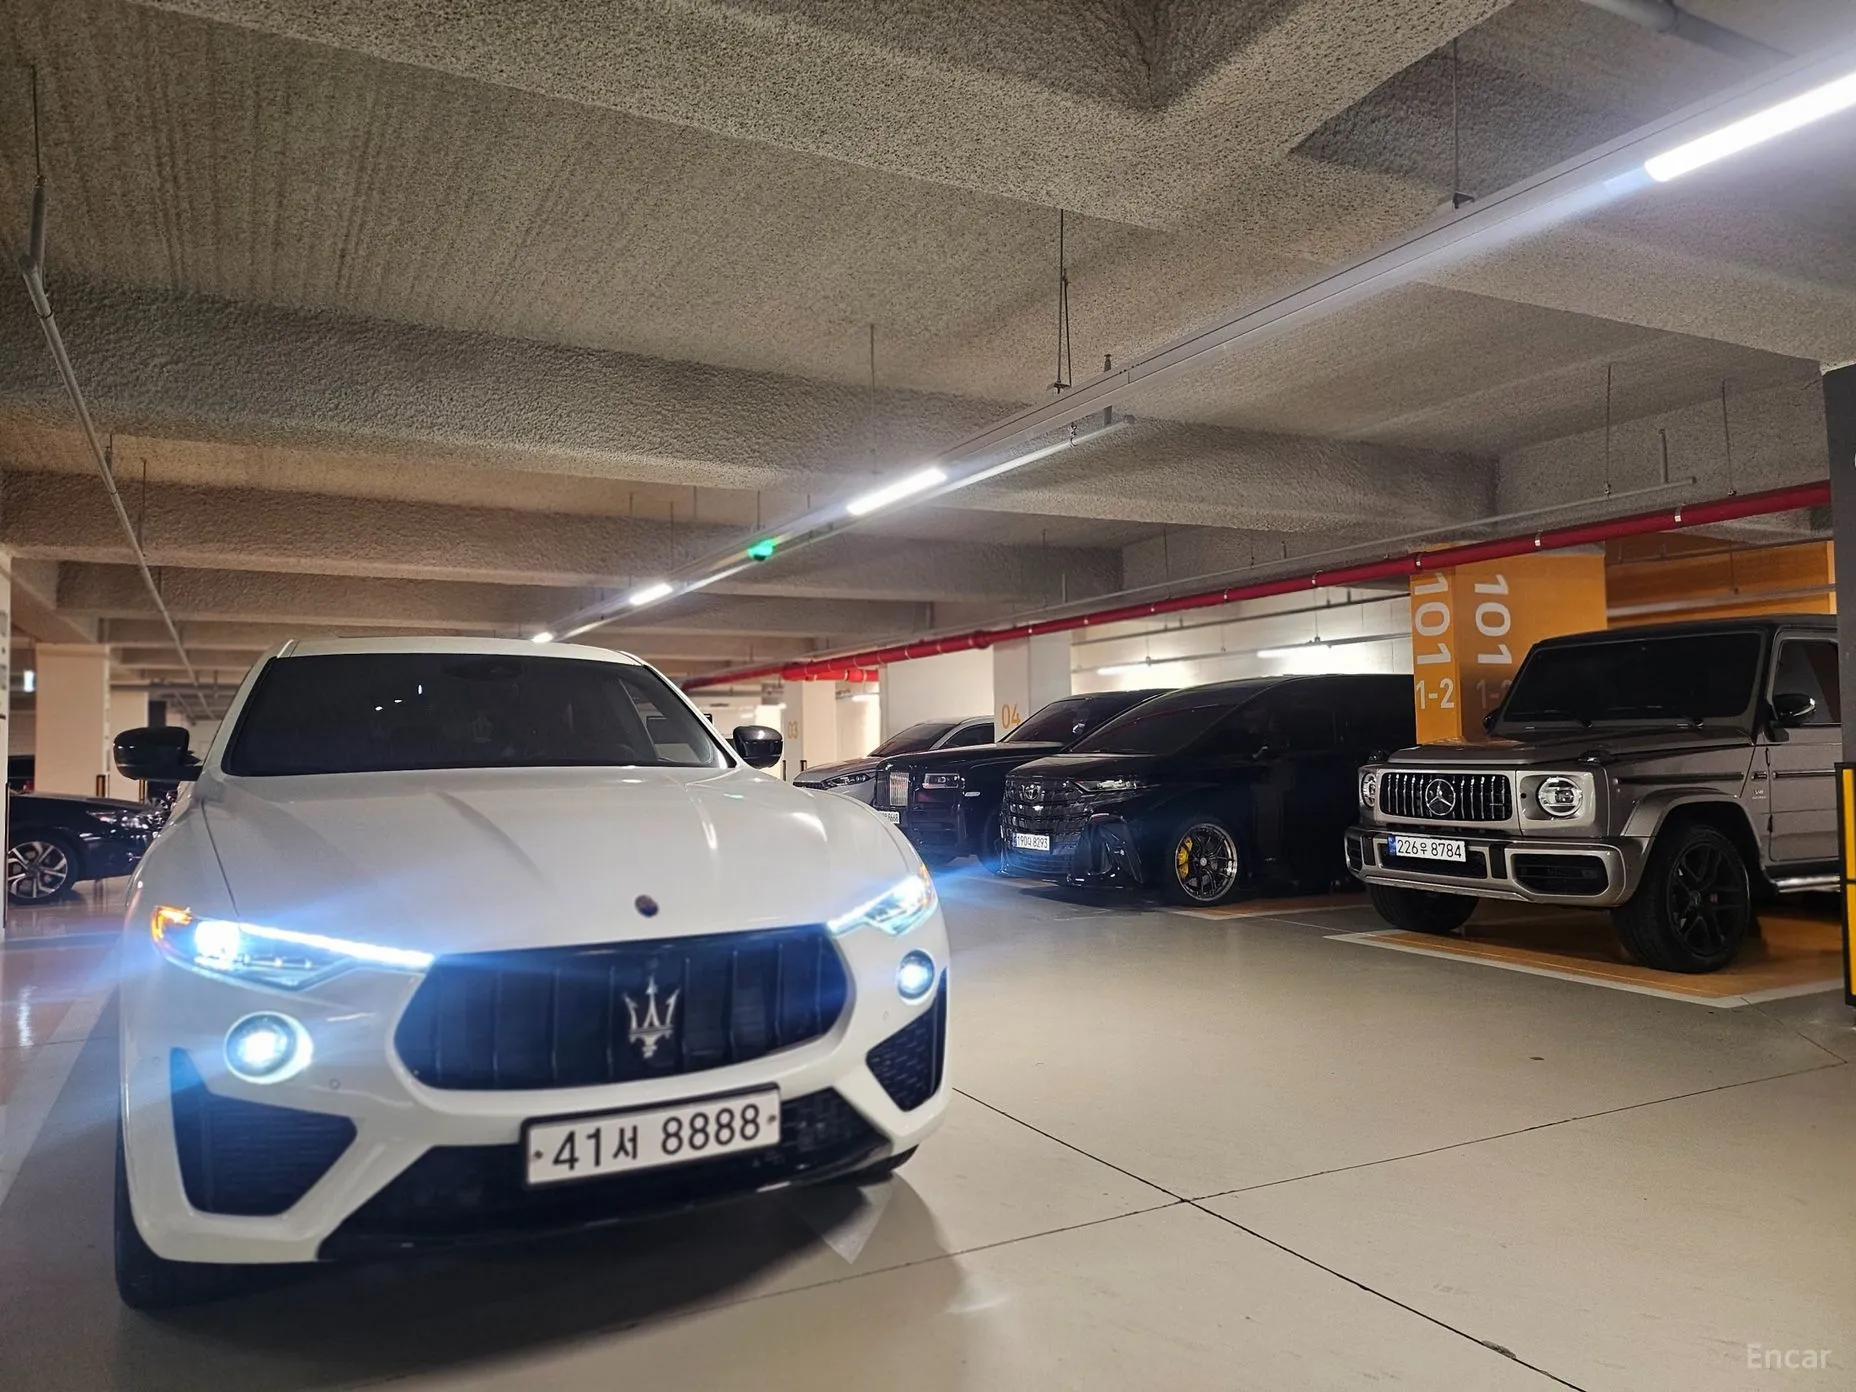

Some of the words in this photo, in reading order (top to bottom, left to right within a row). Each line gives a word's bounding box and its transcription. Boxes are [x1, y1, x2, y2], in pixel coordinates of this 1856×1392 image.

[1415, 573, 1451, 664] 101
[1475, 574, 1513, 665] 101
[1002, 703, 1021, 729] 04
[1416, 678, 1455, 710] 1-2
[1397, 839, 1428, 855] 226우
[1430, 842, 1462, 858] 8784
[552, 1124, 638, 1171] 41서
[661, 1104, 761, 1155] 8888
